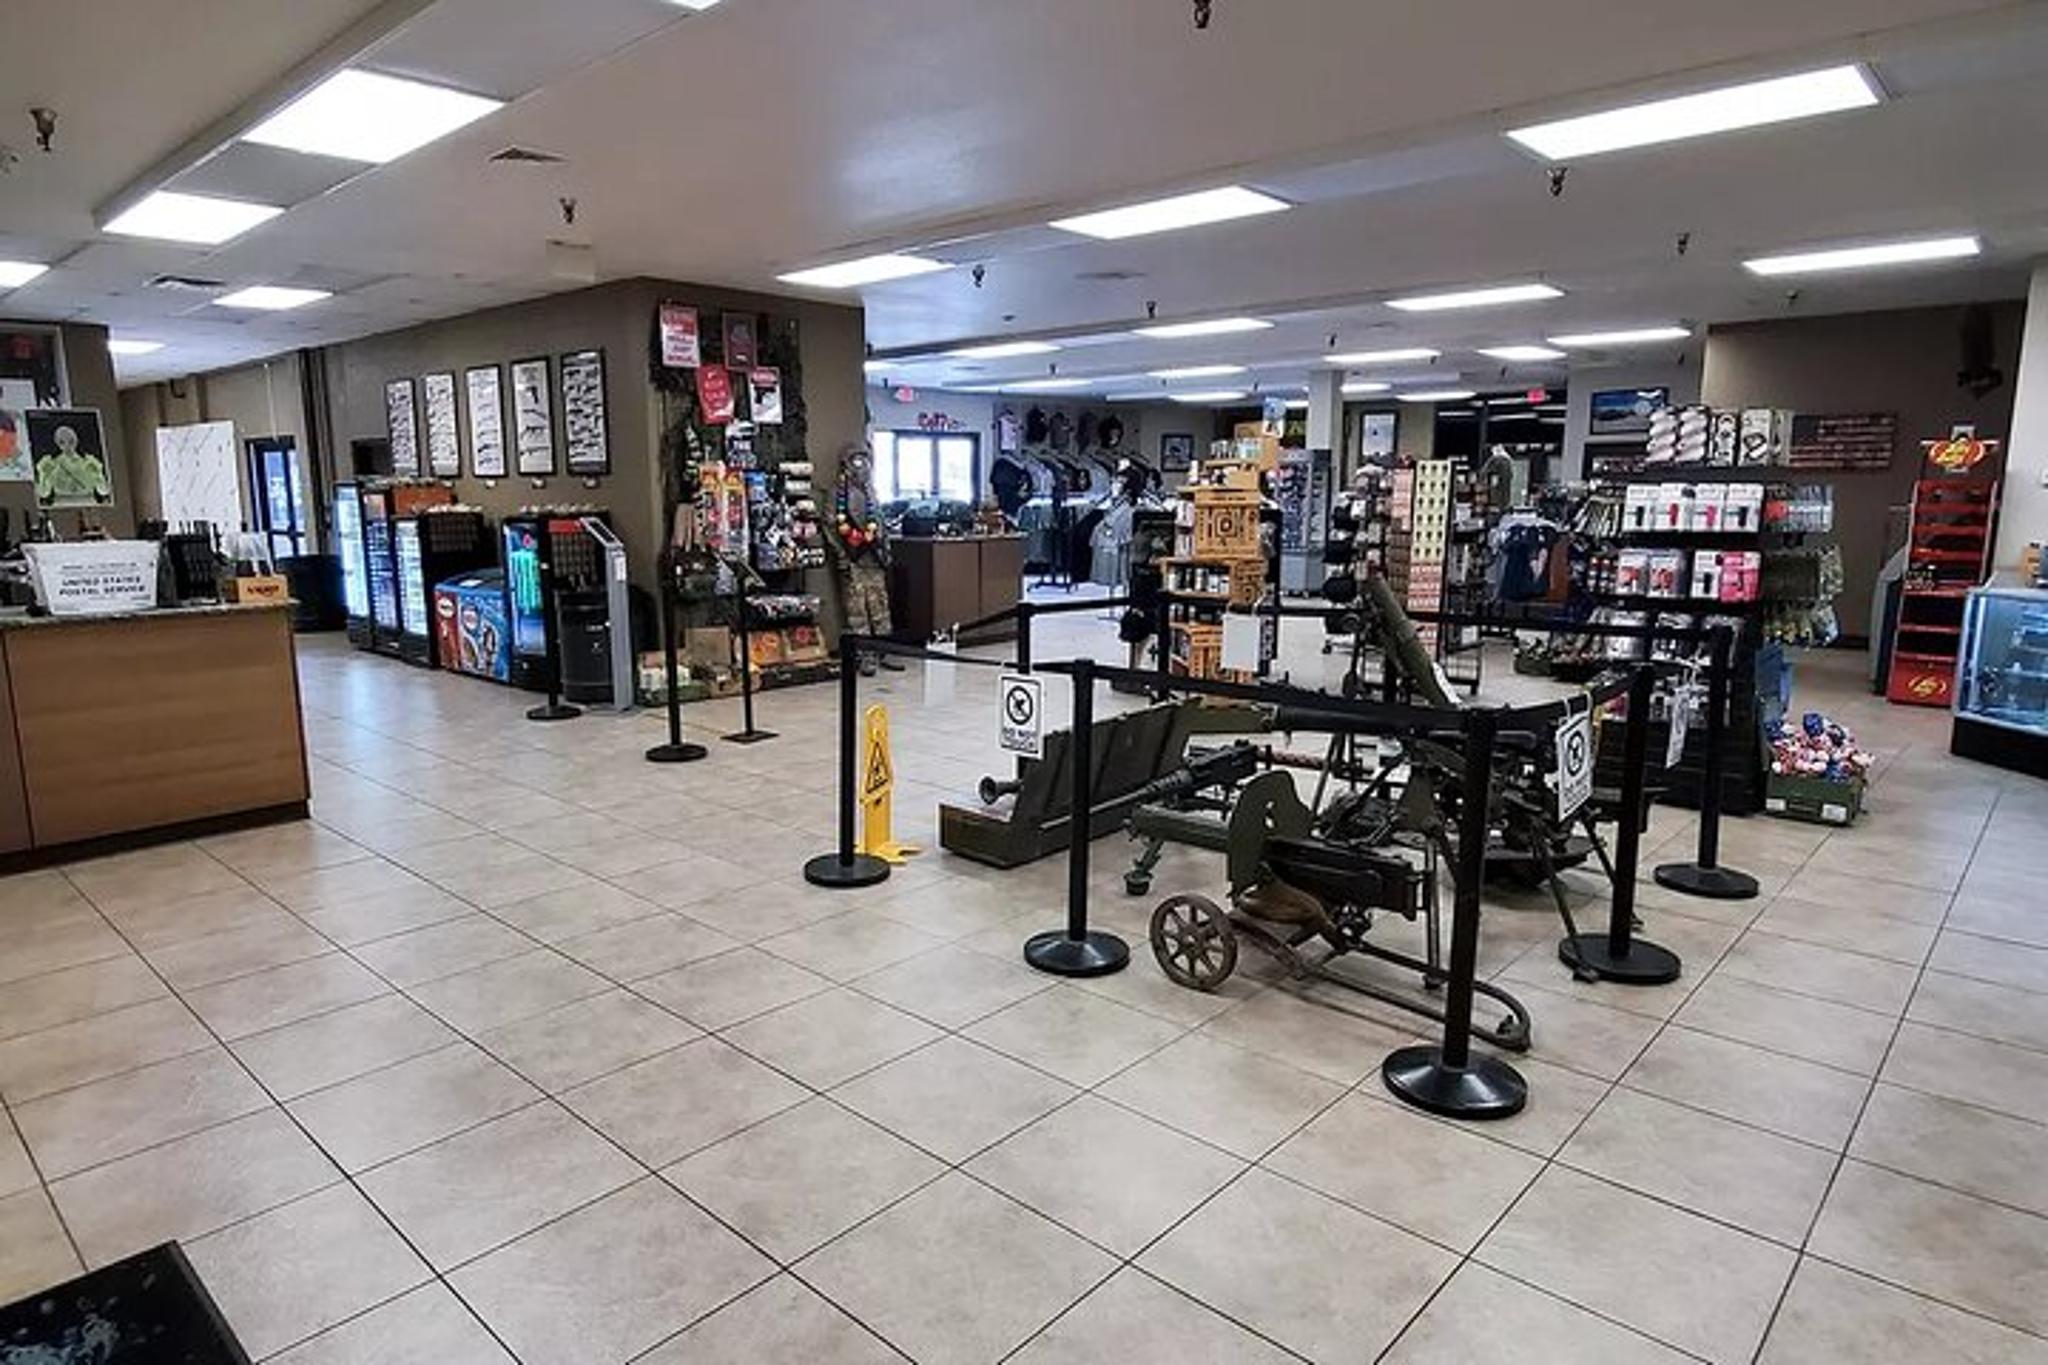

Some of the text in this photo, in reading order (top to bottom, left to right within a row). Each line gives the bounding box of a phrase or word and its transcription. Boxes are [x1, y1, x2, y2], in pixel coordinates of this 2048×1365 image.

[62, 575, 140, 587] UNITED STATES
[59, 584, 145, 596] POSTAL SERVICE
